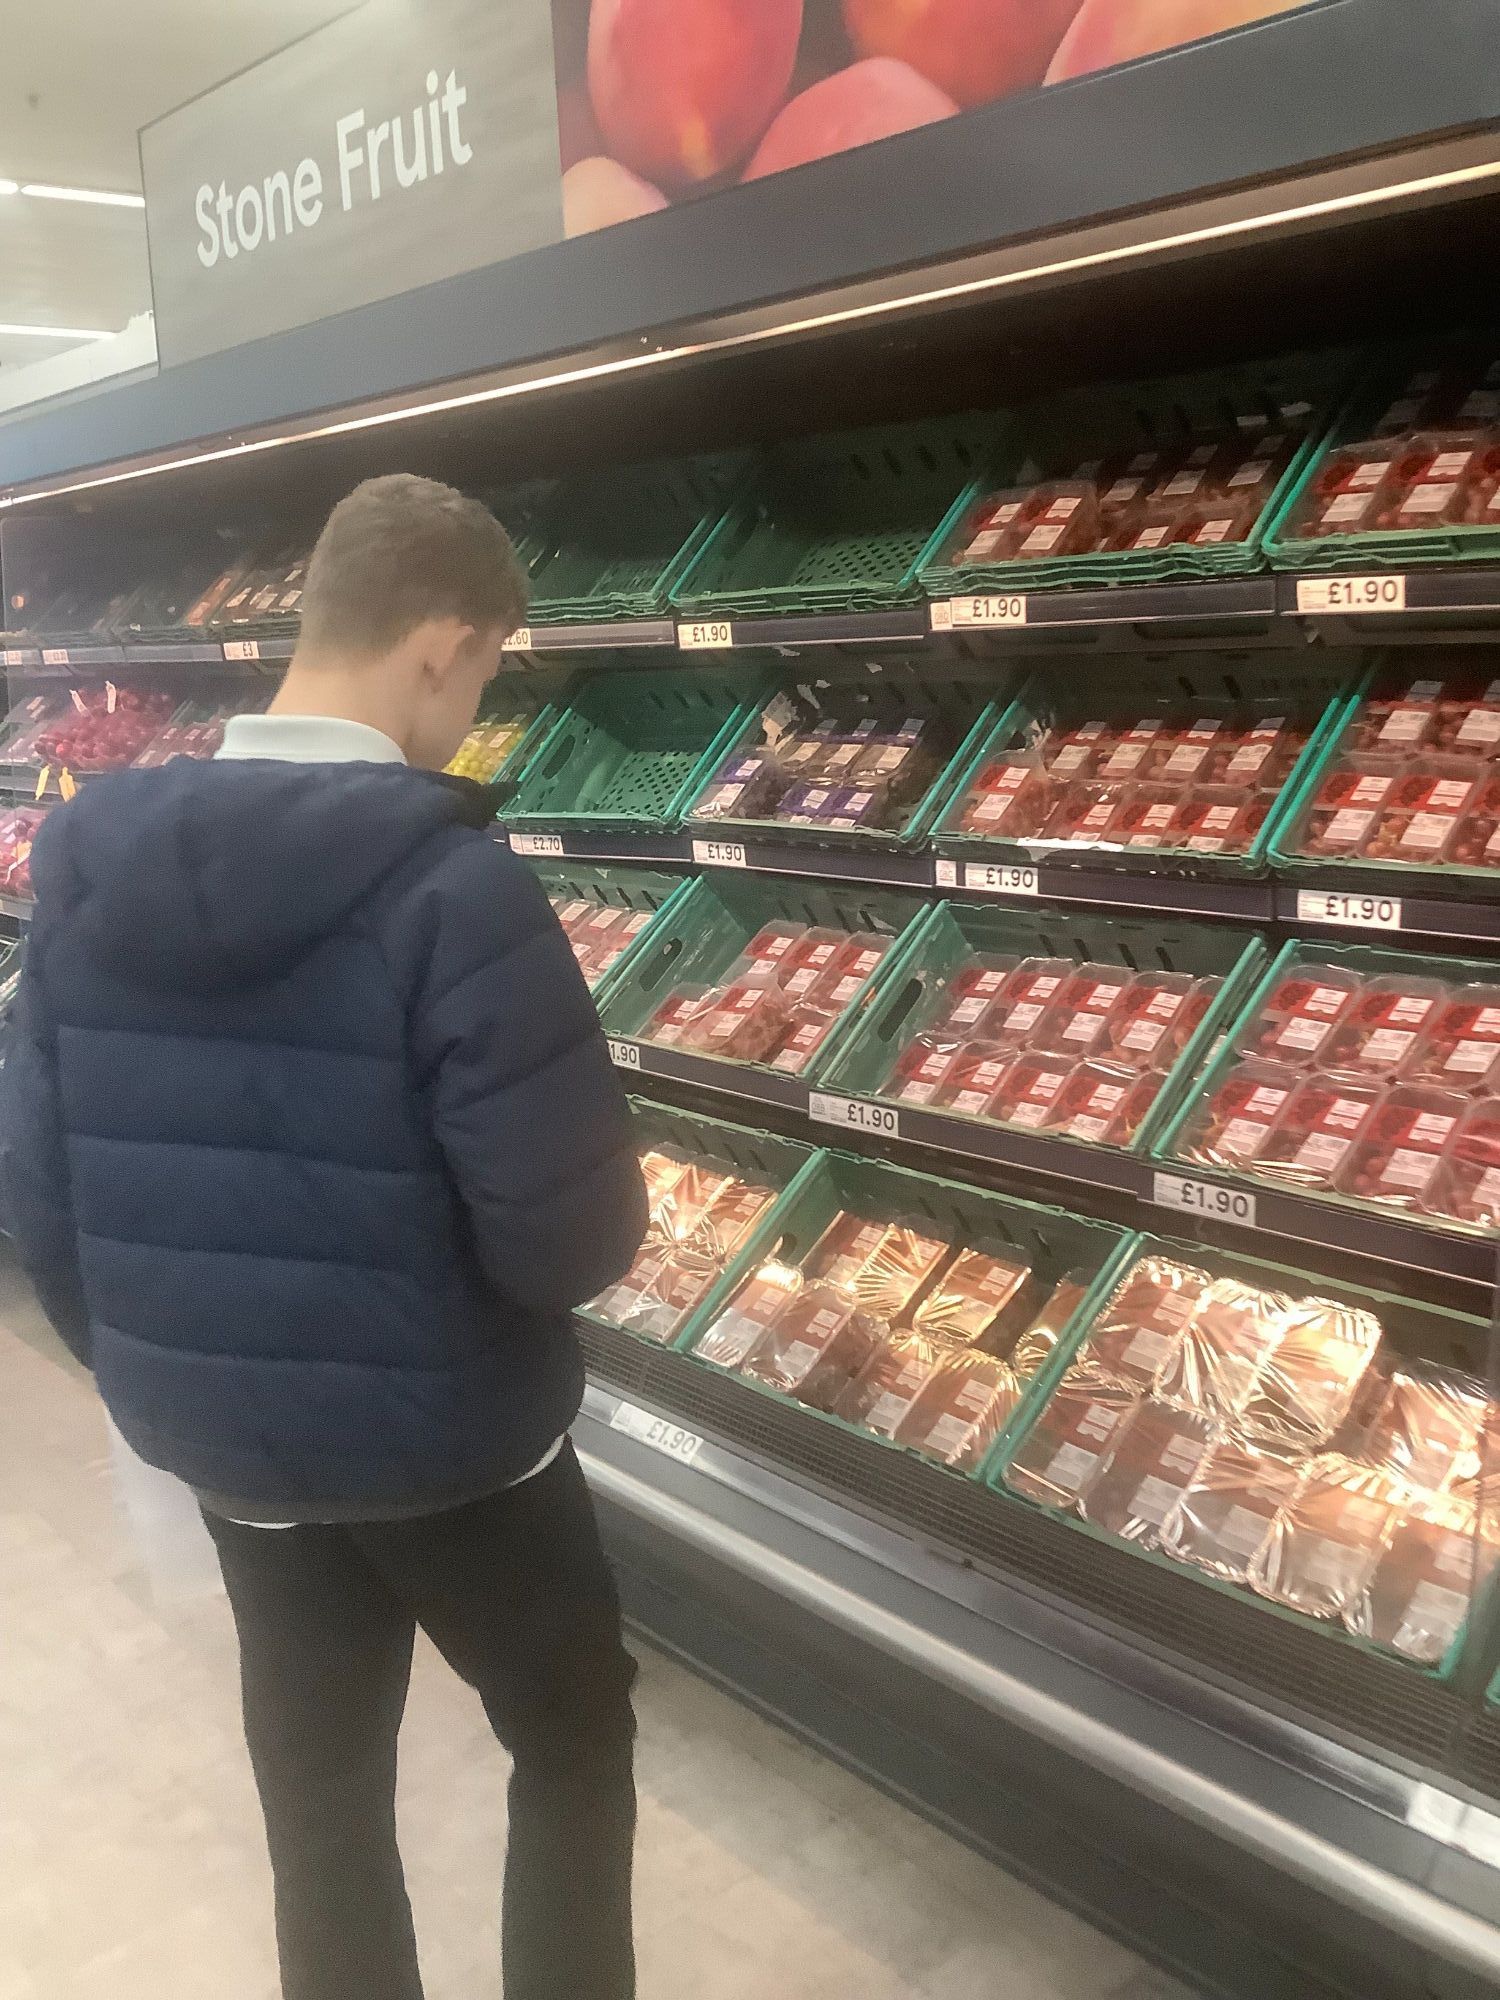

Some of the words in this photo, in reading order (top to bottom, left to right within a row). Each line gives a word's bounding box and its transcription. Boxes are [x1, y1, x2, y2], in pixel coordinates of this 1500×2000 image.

[196, 158, 323, 268] Stone
[336, 69, 473, 211] Fruit
[1328, 580, 1398, 604] £1.90
[972, 598, 1021, 618] £1.90
[693, 625, 728, 642] £1.90
[242, 641, 253, 657] £3
[533, 837, 560, 851] £2.70
[707, 843, 742, 861] £1.90
[986, 867, 1034, 888] £1.90
[1326, 895, 1393, 922] £1.90
[611, 1043, 637, 1064] 1.90
[847, 1103, 895, 1130] £1.90
[1181, 1182, 1248, 1218] £1.90
[646, 1421, 697, 1455] £1.90
